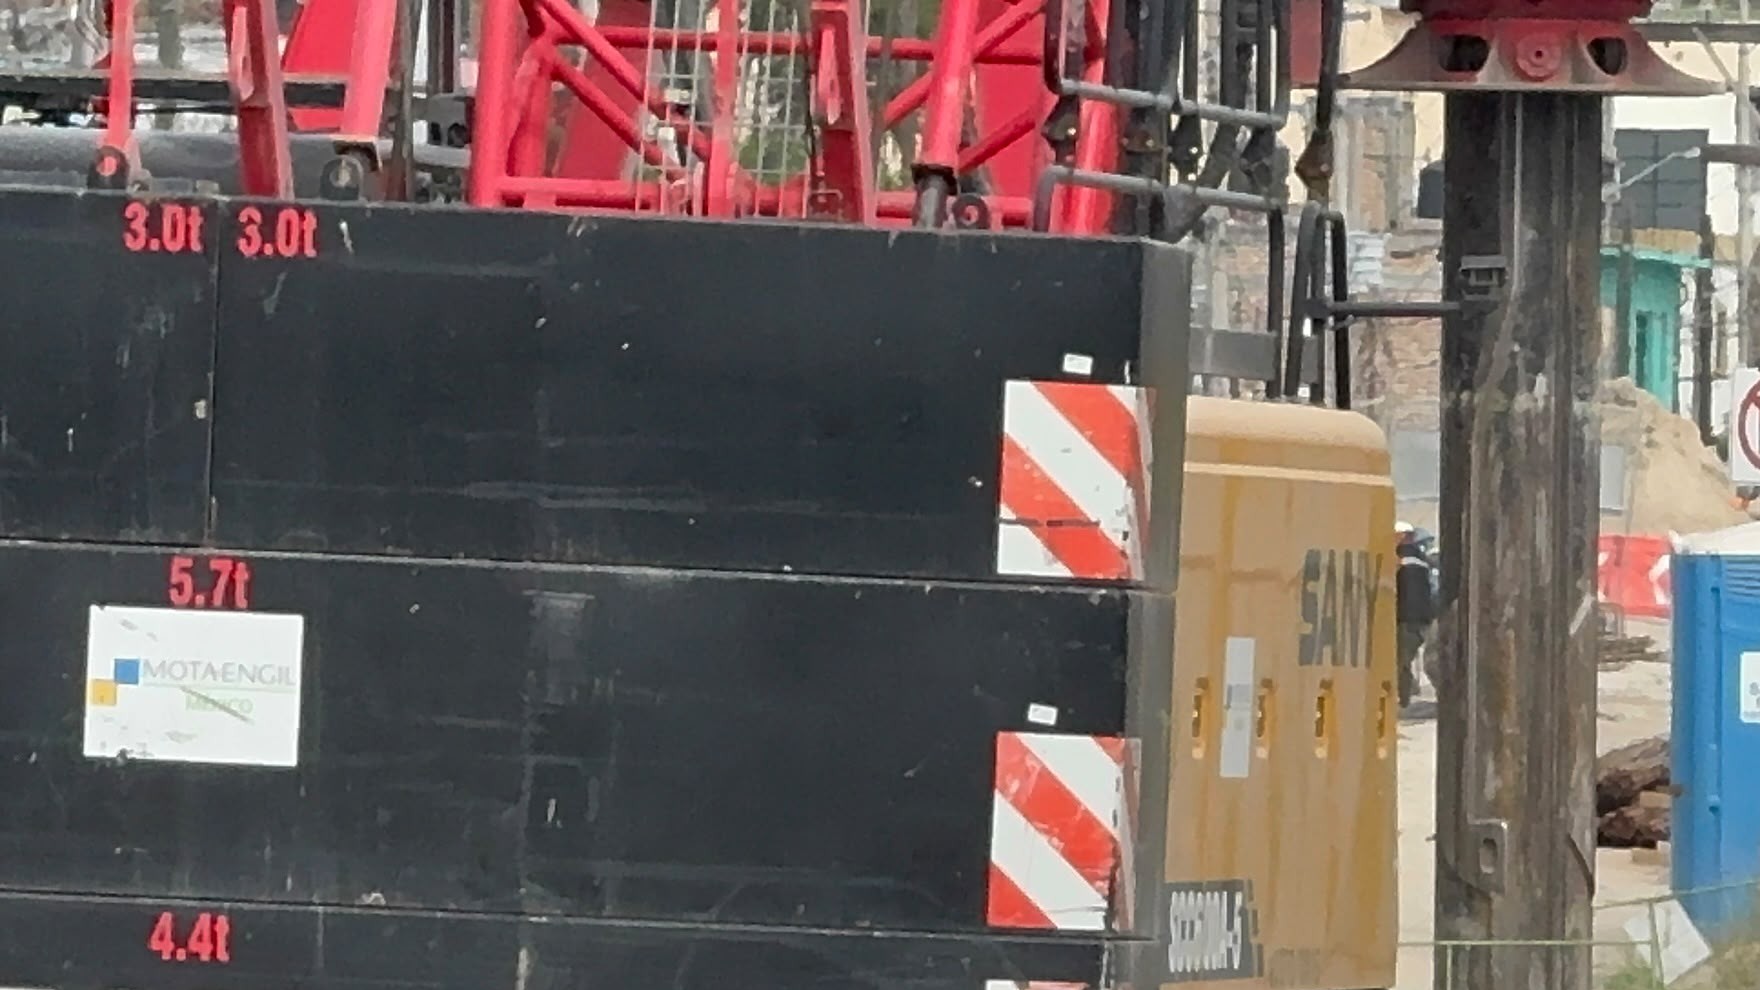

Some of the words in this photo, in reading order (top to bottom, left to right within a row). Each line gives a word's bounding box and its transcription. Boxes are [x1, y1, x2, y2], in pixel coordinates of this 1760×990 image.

[123, 200, 205, 252] 3.0t
[237, 205, 318, 258] 3.0t
[168, 556, 251, 609] 5.7t
[1299, 548, 1384, 667] SANY
[149, 911, 231, 963] 4.4t
